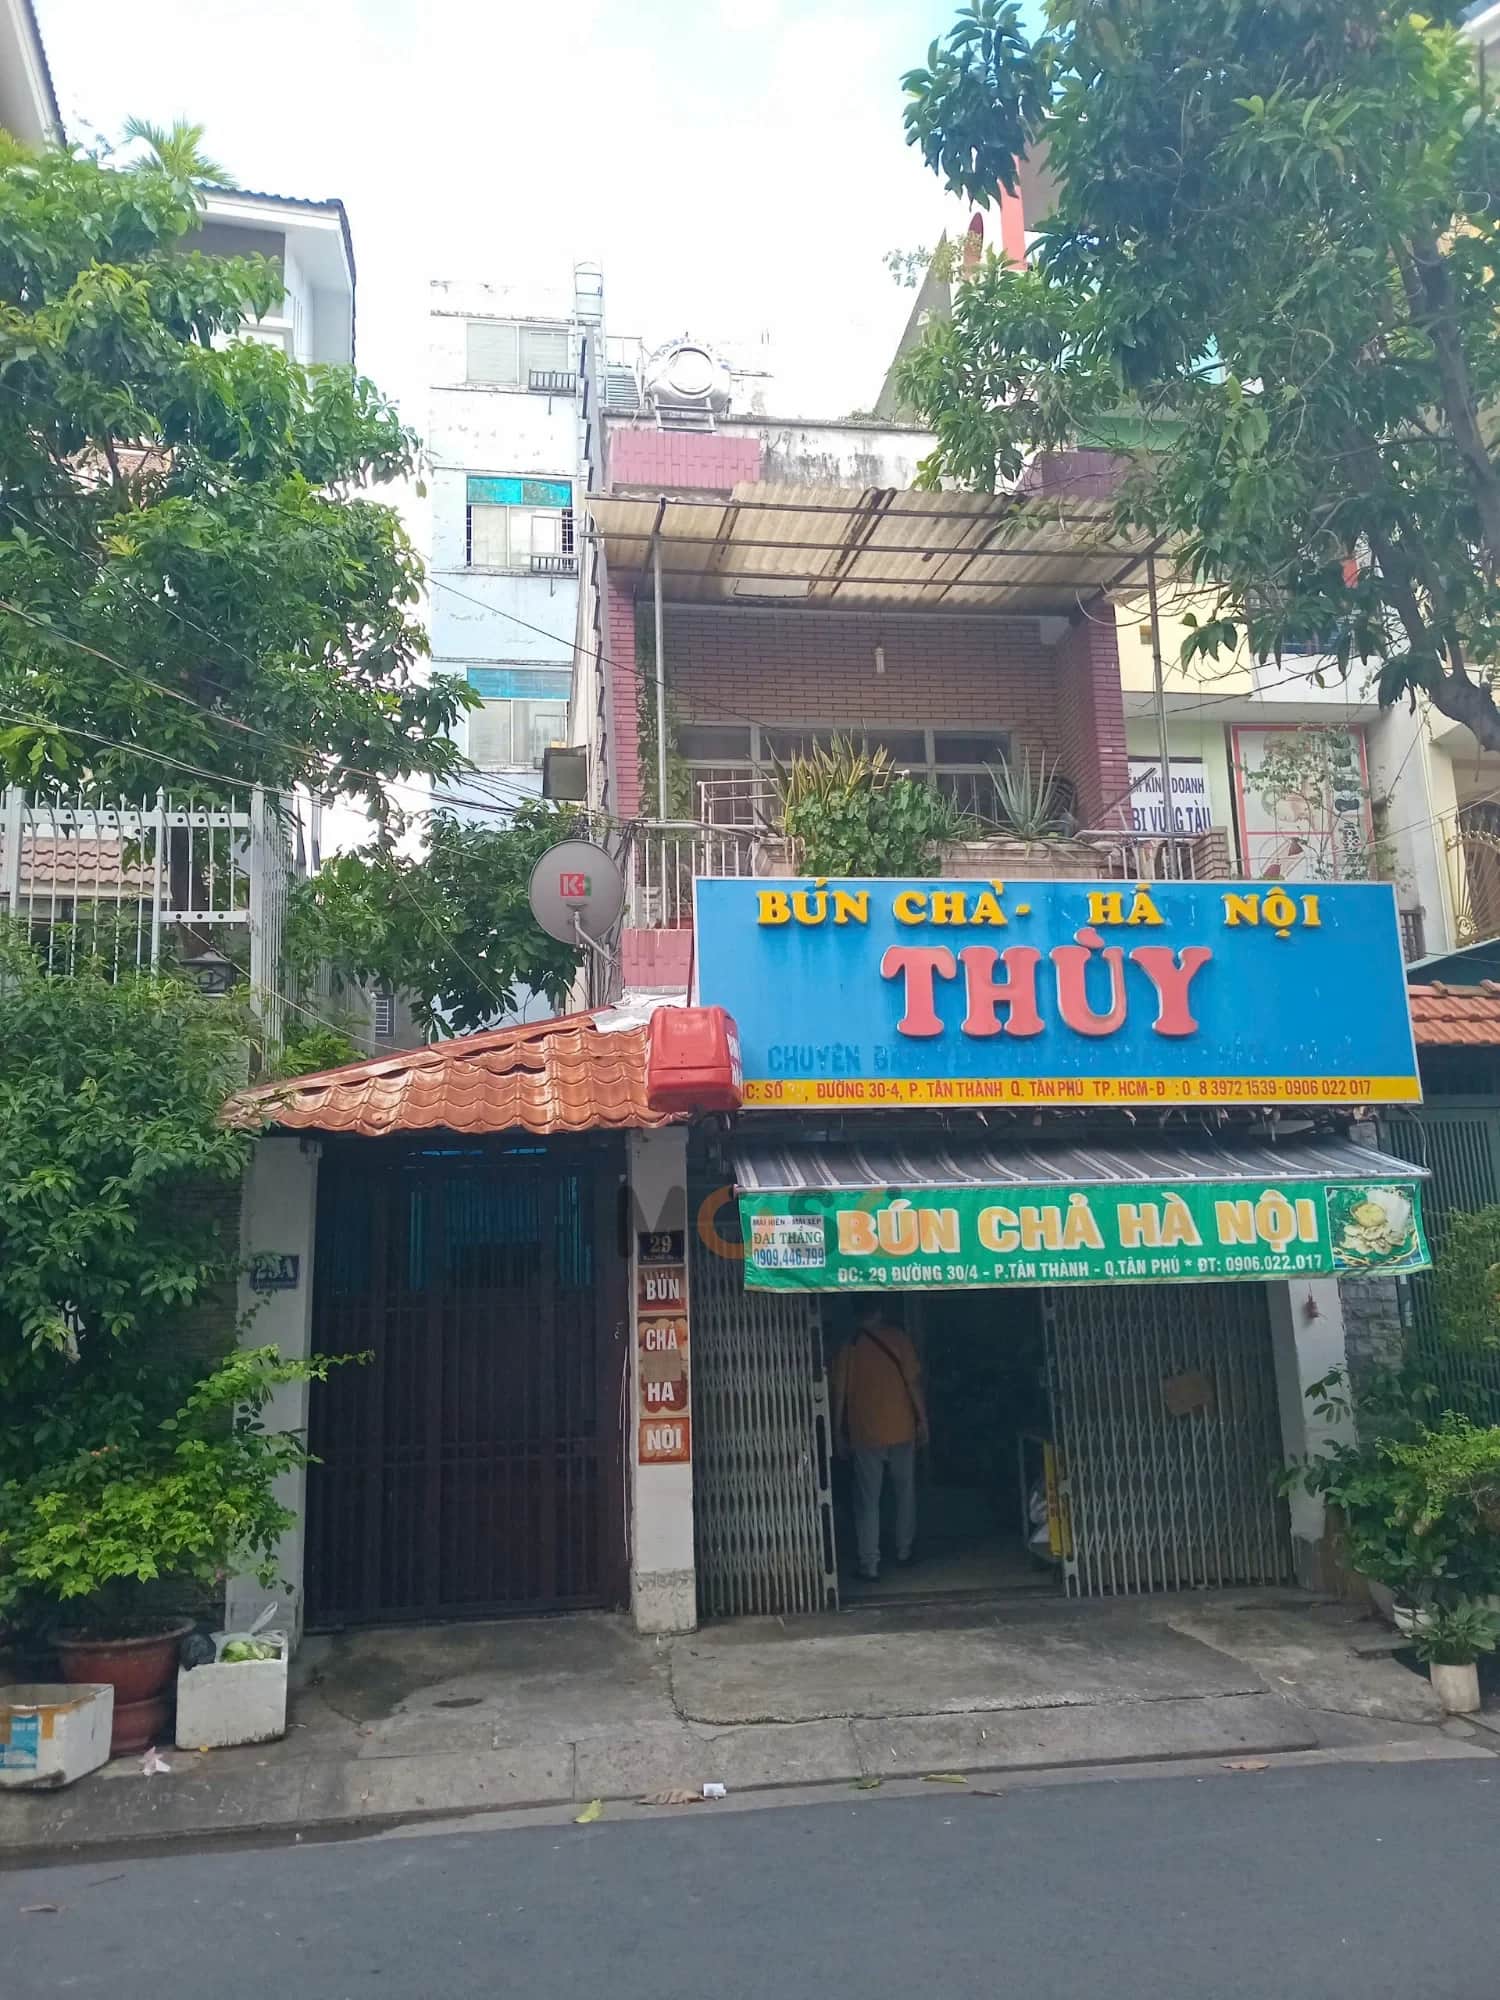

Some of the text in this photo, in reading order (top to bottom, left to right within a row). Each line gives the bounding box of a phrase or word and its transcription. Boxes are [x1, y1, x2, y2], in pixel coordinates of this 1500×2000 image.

[1145, 776, 1168, 793] KIN
[1171, 777, 1205, 794] DOANH
[1149, 800, 1184, 832] VŨG
[1186, 799, 1212, 833] TÀU
[756, 877, 871, 925] BÚN
[1221, 886, 1322, 938] NỘI
[742, 1082, 760, 1099] C:
[764, 1079, 784, 1099] SỐ
[816, 1079, 865, 1099] ĐƯỜNG
[956, 1079, 1003, 1097] THÀNH
[1029, 1079, 1055, 1097] TÂN
[1058, 1078, 1084, 1097] PHÚ
[1211, 1080, 1242, 1096] 3972
[1321, 1079, 1346, 1096] 022
[1350, 1079, 1371, 1096] 017
[836, 1189, 1319, 1256] BÚN CHẢ HÀ NỘI
[649, 1234, 672, 1254] 29
[838, 1266, 863, 1283] ĐC:
[869, 1266, 887, 1283] 29
[892, 1262, 942, 1282] ĐƯỜNG
[947, 1264, 979, 1282] 30/4
[1040, 1258, 1089, 1278] THÀNH
[1152, 1255, 1181, 1274] PHÚ
[1197, 1258, 1222, 1273] ĐT:
[1225, 1253, 1324, 1273] 0906.022.017
[646, 1273, 680, 1300] BÚN
[646, 1321, 678, 1351] CHẢ
[646, 1424, 682, 1453] NỘI
